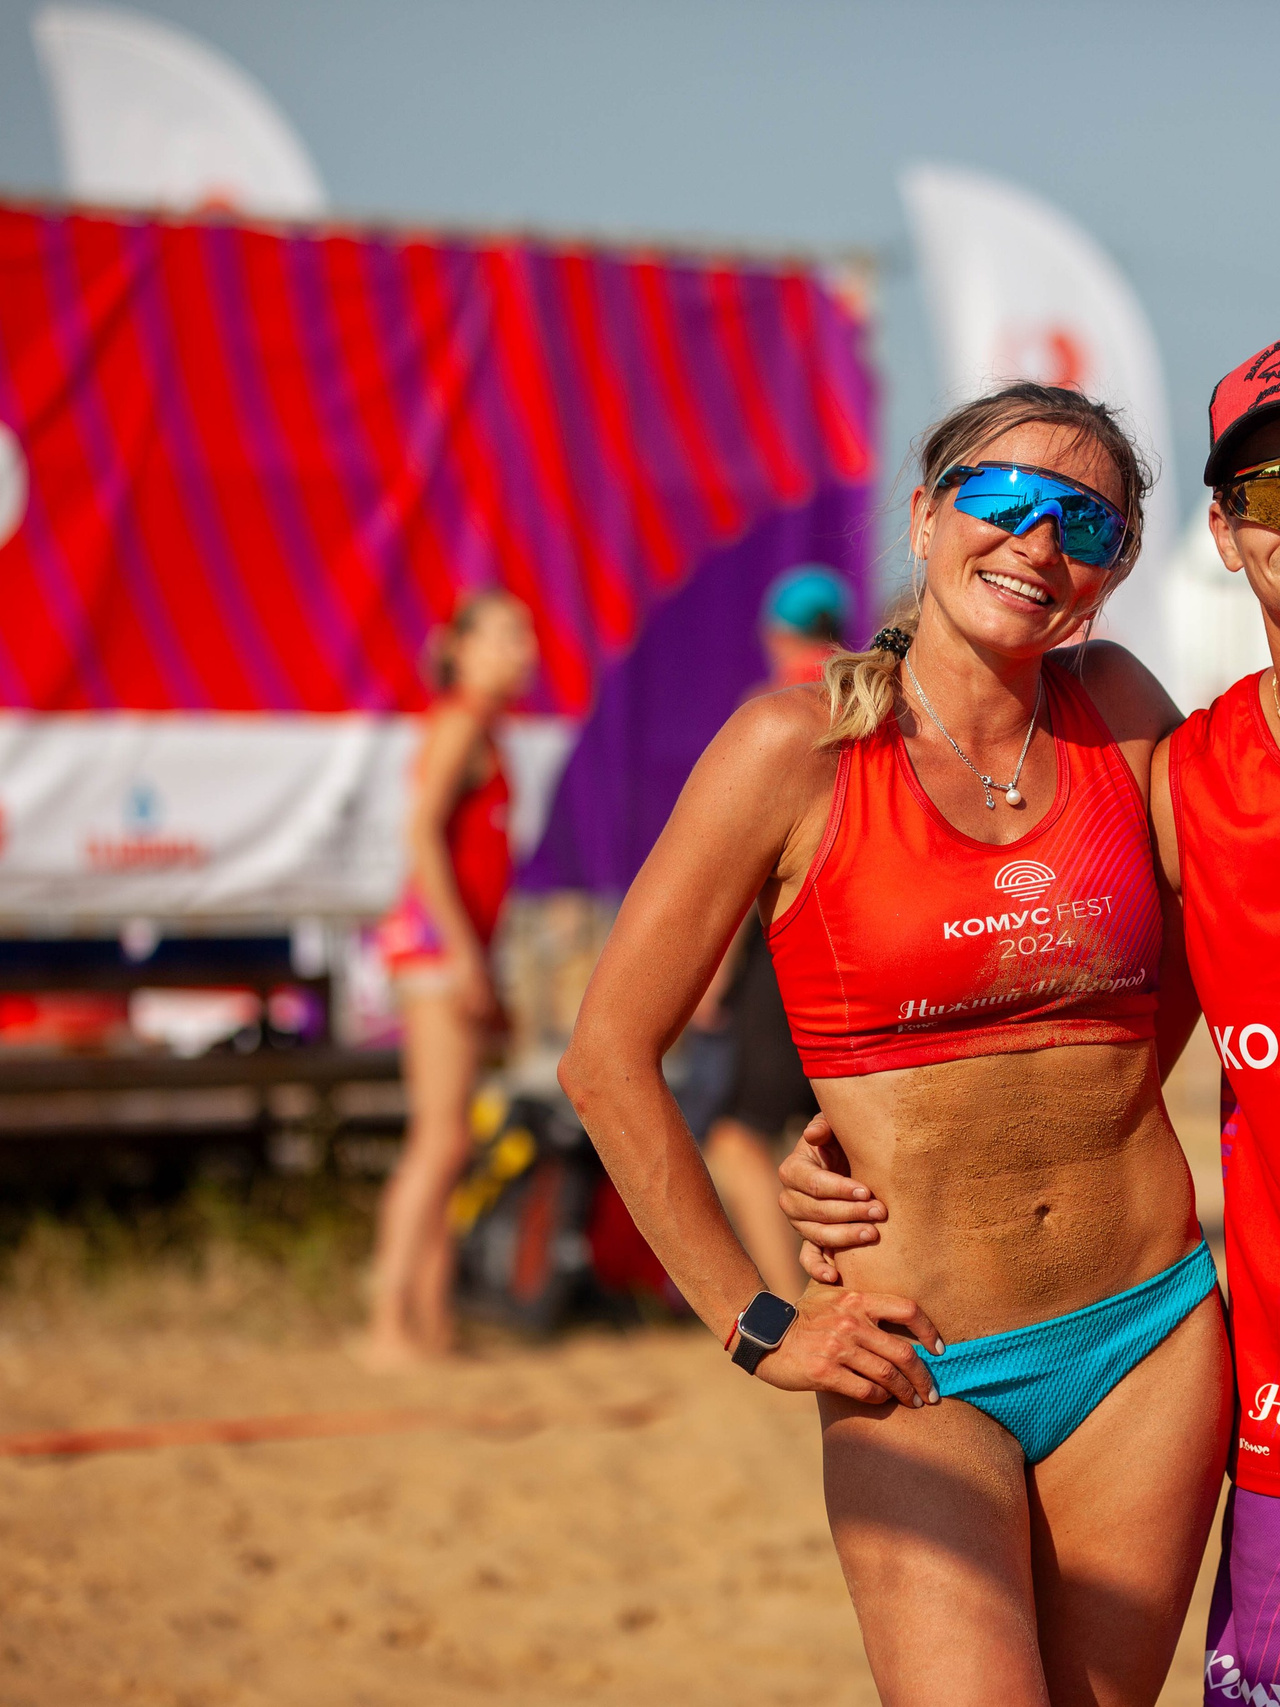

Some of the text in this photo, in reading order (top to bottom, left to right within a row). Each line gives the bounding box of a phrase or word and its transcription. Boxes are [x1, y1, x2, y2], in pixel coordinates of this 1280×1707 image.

[943, 895, 1113, 940] КОМУС FEST
[999, 929, 1076, 959] 2024
[897, 987, 1021, 1019] Нижний
